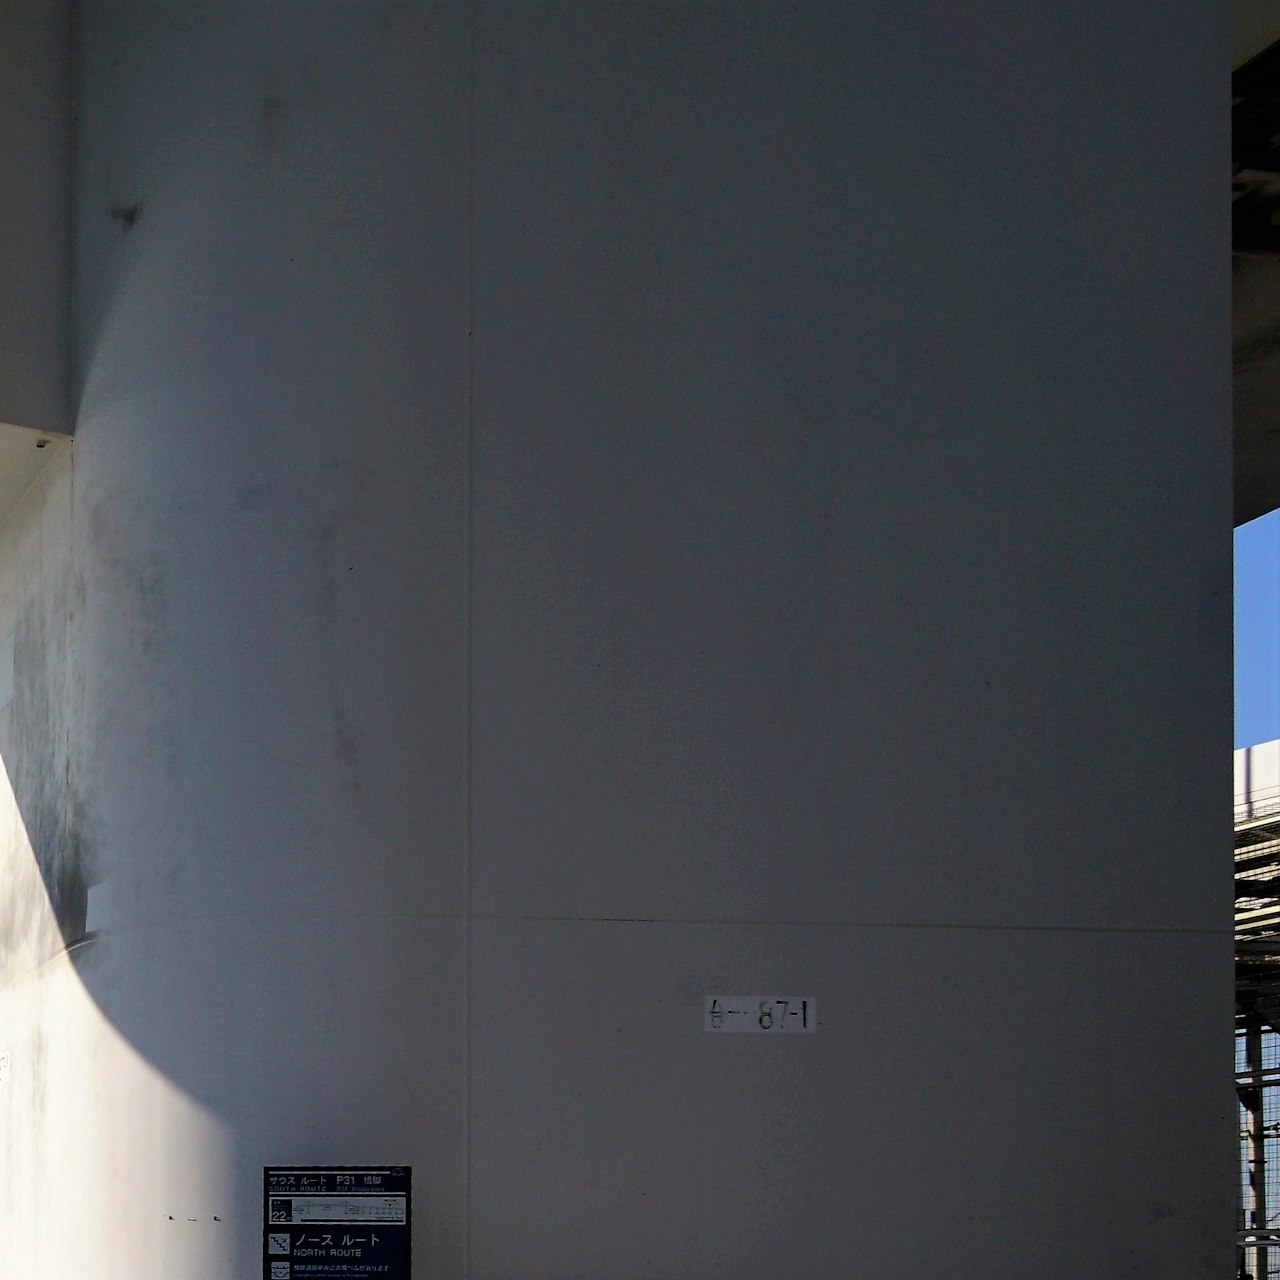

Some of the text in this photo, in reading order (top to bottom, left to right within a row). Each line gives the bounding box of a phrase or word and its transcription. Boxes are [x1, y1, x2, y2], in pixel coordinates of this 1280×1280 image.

[269, 1176, 296, 1185] サウス
[301, 1176, 327, 1185] ルート
[336, 1176, 355, 1185] P31
[295, 1234, 380, 1246] ノース ルート
[293, 1249, 362, 1257] NORTH ROUTE
